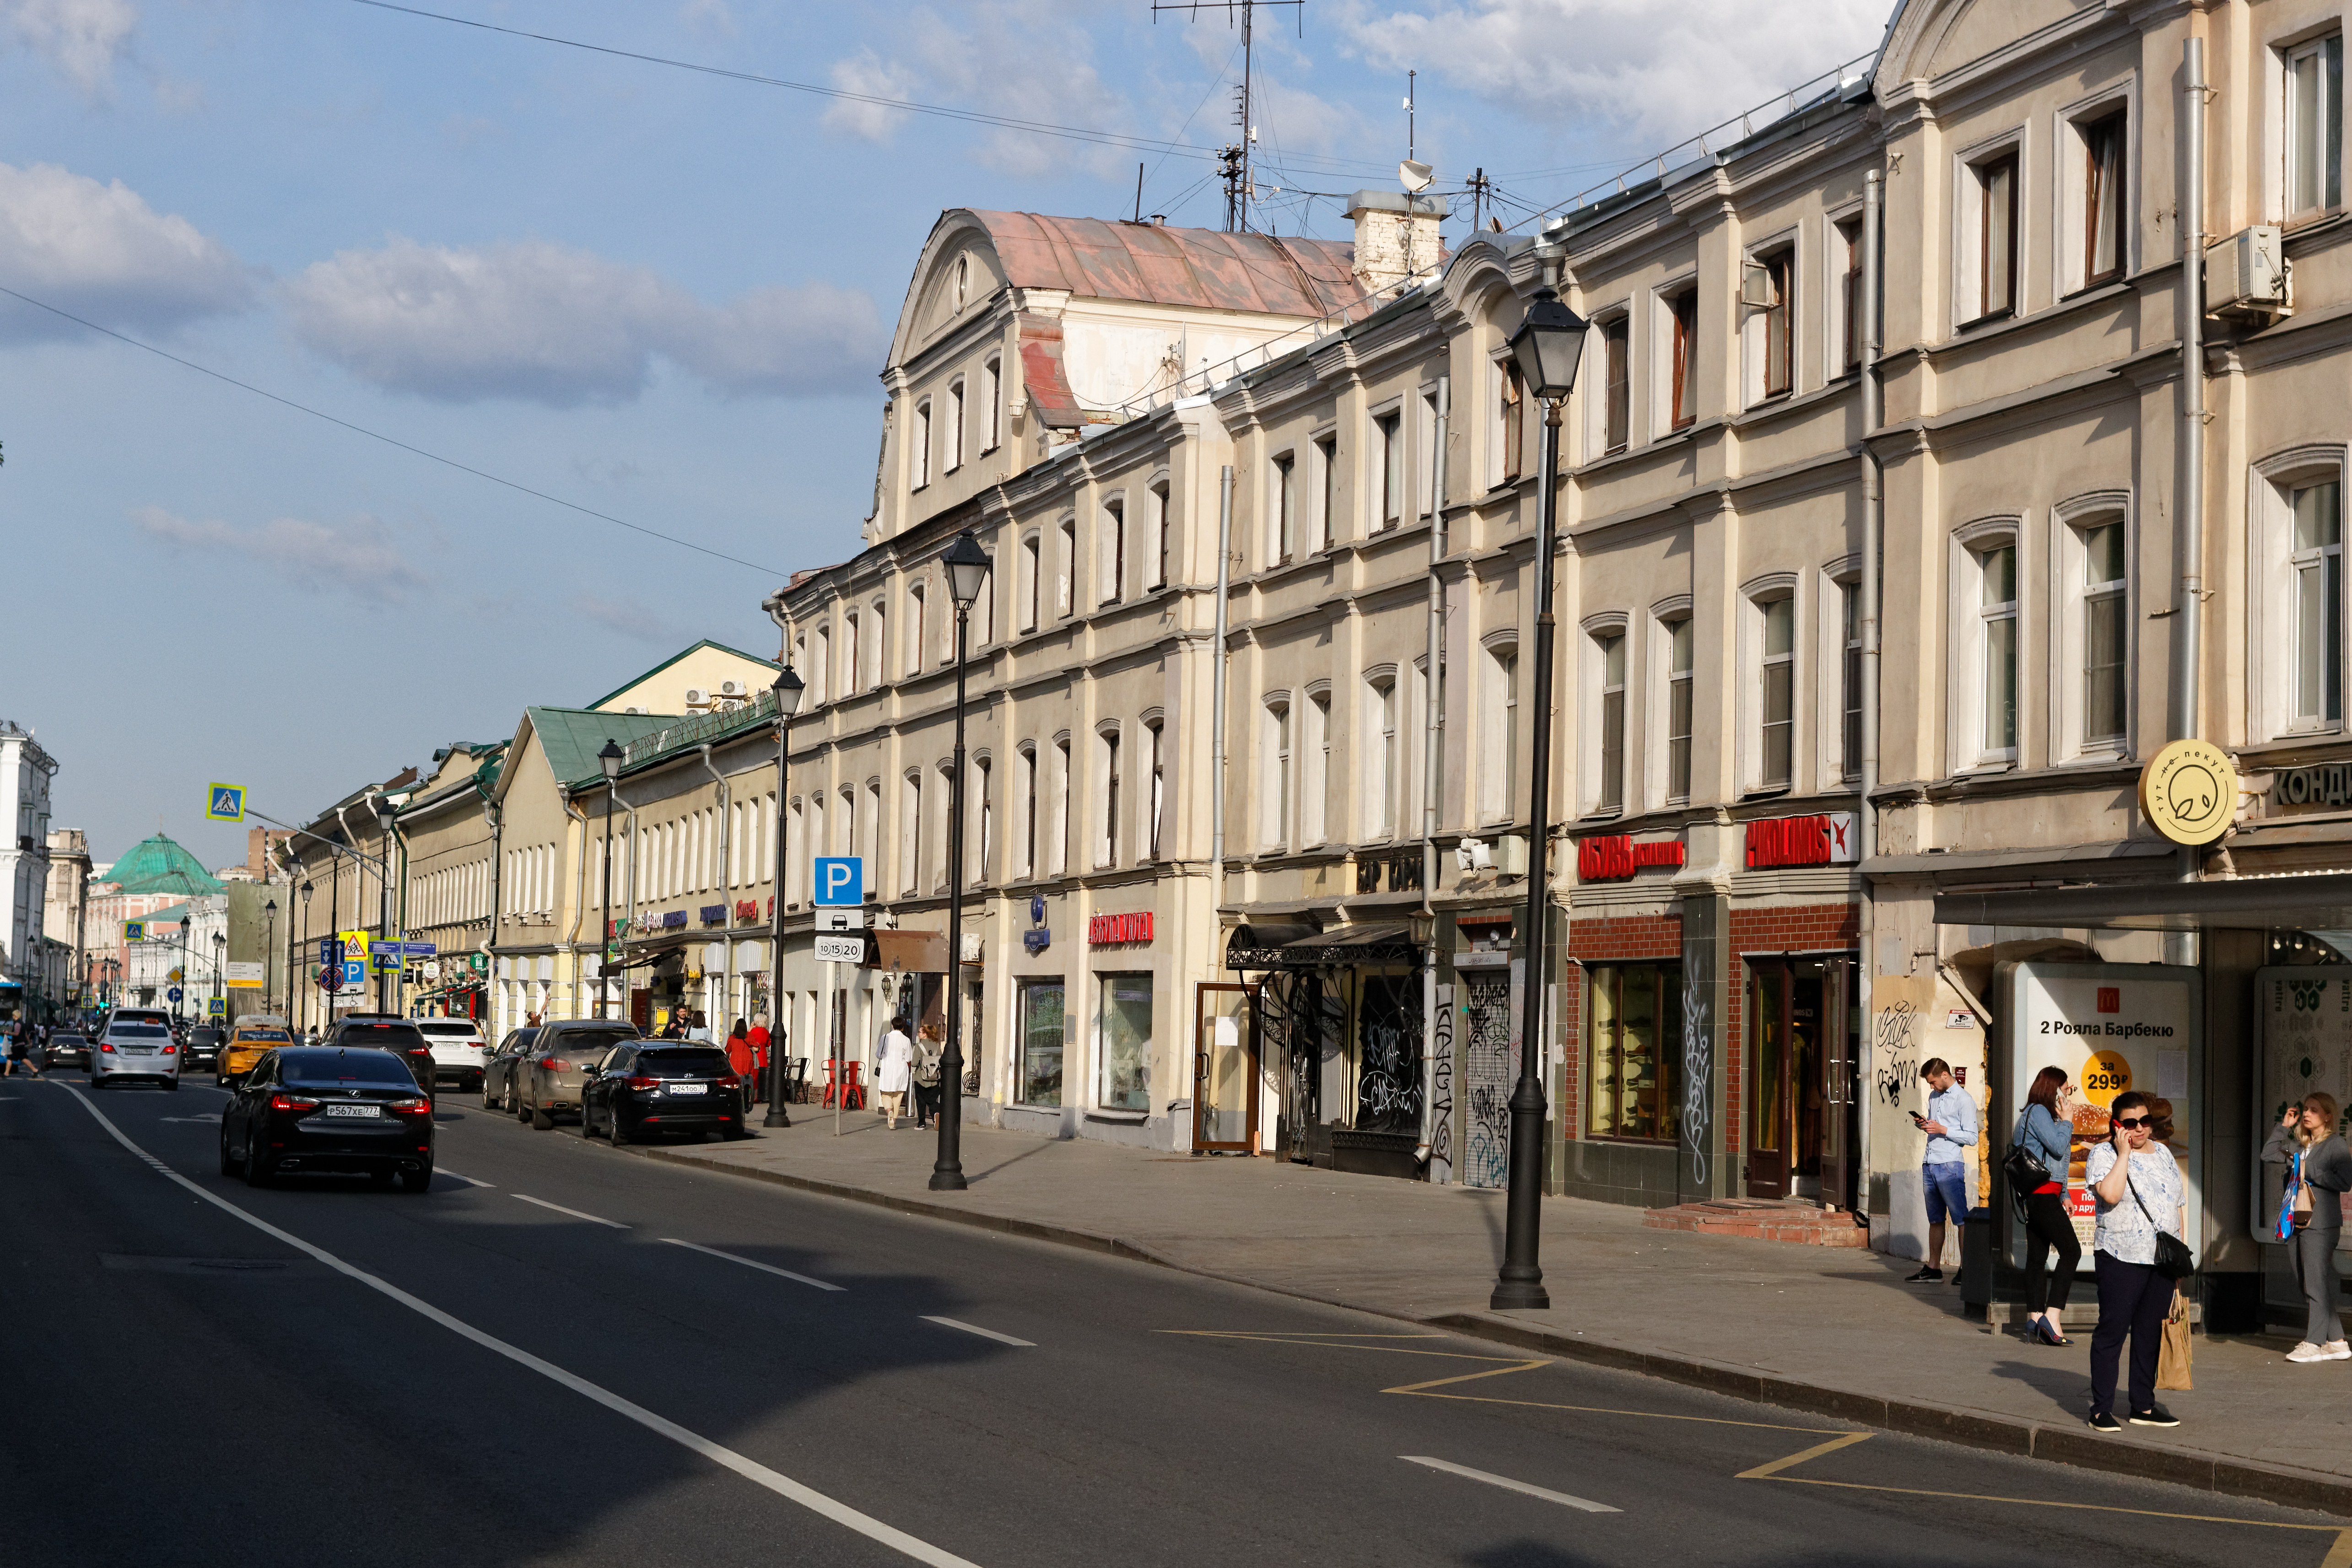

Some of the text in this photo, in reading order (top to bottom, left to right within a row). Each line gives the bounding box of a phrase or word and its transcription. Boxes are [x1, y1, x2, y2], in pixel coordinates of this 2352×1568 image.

[2185, 751, 2225, 774] пекут
[1746, 815, 1830, 867] PIKOLINOS
[1579, 835, 1635, 880] ОБУВЬ
[828, 863, 852, 899] P
[1357, 860, 1381, 895] БАР
[1033, 898, 1036, 913] 4
[1088, 912, 1148, 943] АЗБУКА УЮТА
[831, 945, 840, 954] 15
[844, 945, 858, 955] 20
[348, 964, 360, 980] P
[2041, 1021, 2174, 1040] 2 Рояла Барбекю
[2100, 1062, 2114, 1071] за
